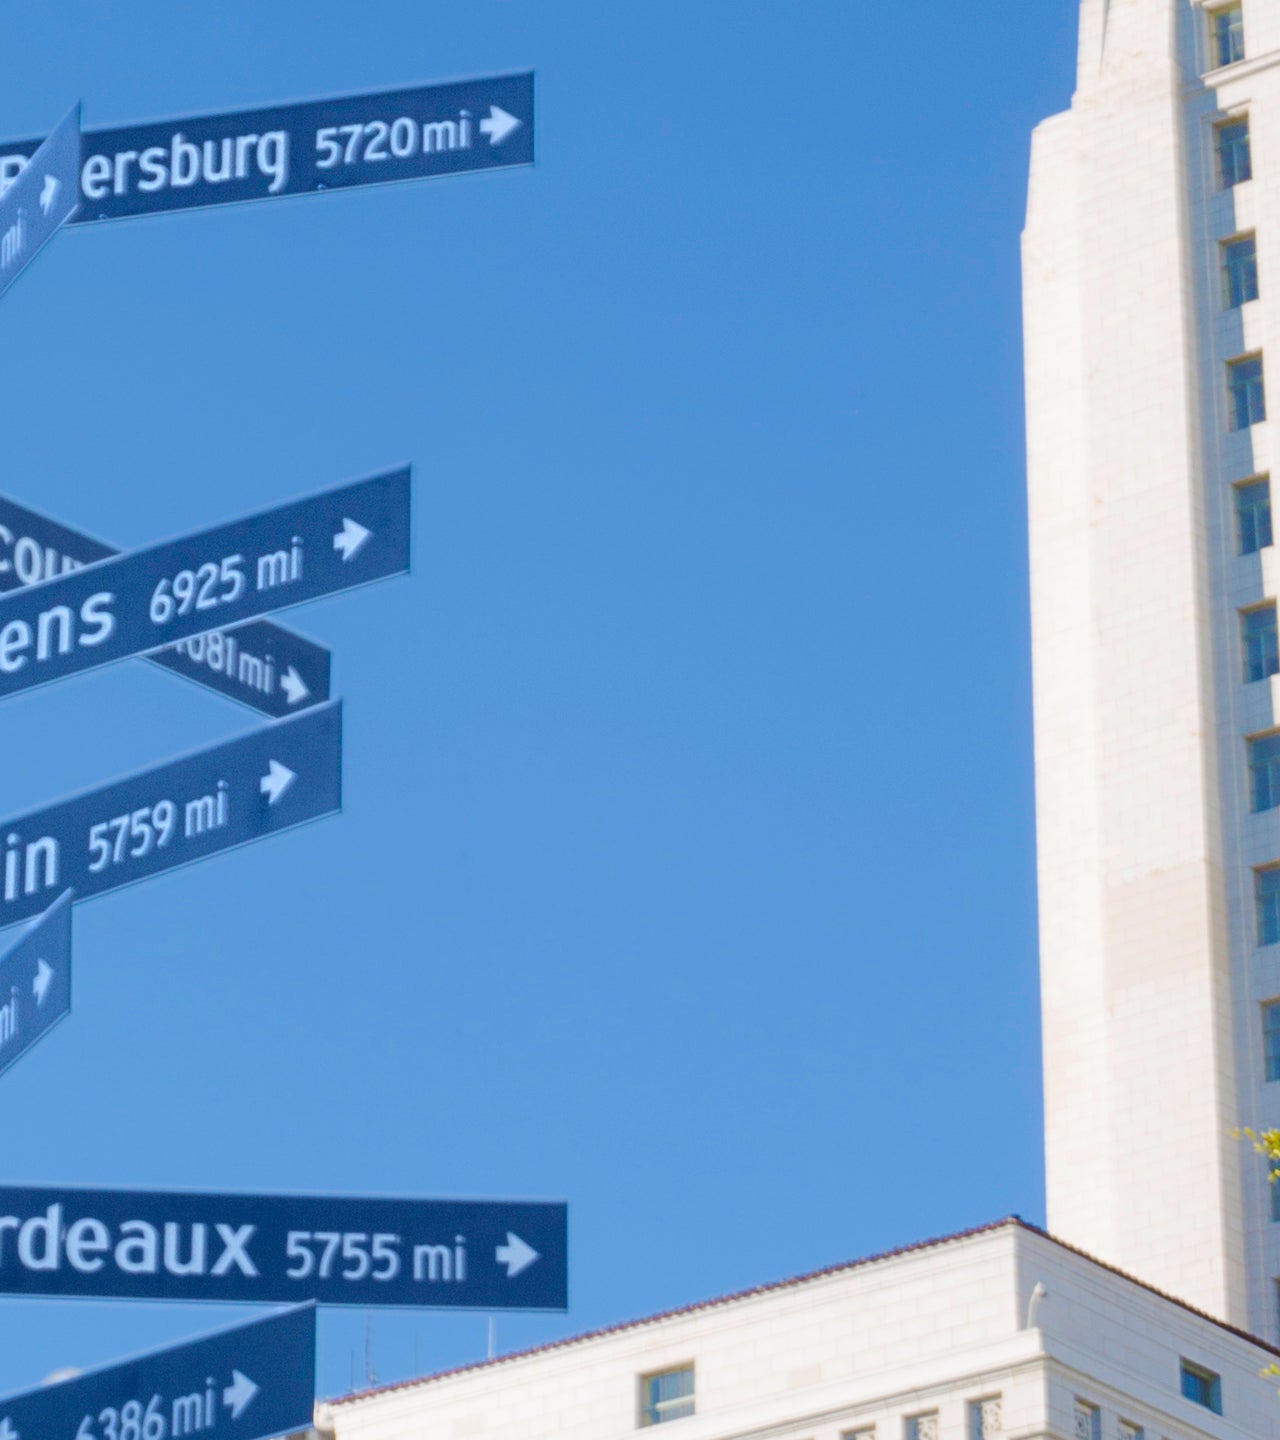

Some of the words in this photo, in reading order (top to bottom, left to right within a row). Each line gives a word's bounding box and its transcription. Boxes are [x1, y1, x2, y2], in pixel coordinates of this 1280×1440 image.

[315, 117, 414, 168] 5720
[423, 111, 469, 153] mi
[1, 209, 26, 270] mi
[149, 554, 244, 623] 6925
[256, 537, 303, 590] mi
[176, 633, 236, 677] 081
[239, 653, 275, 694] mi
[87, 801, 174, 871] 5759
[184, 781, 228, 837] mi
[286, 1232, 398, 1280] 5755
[413, 1237, 465, 1281] mi
[172, 1377, 215, 1434] mi
